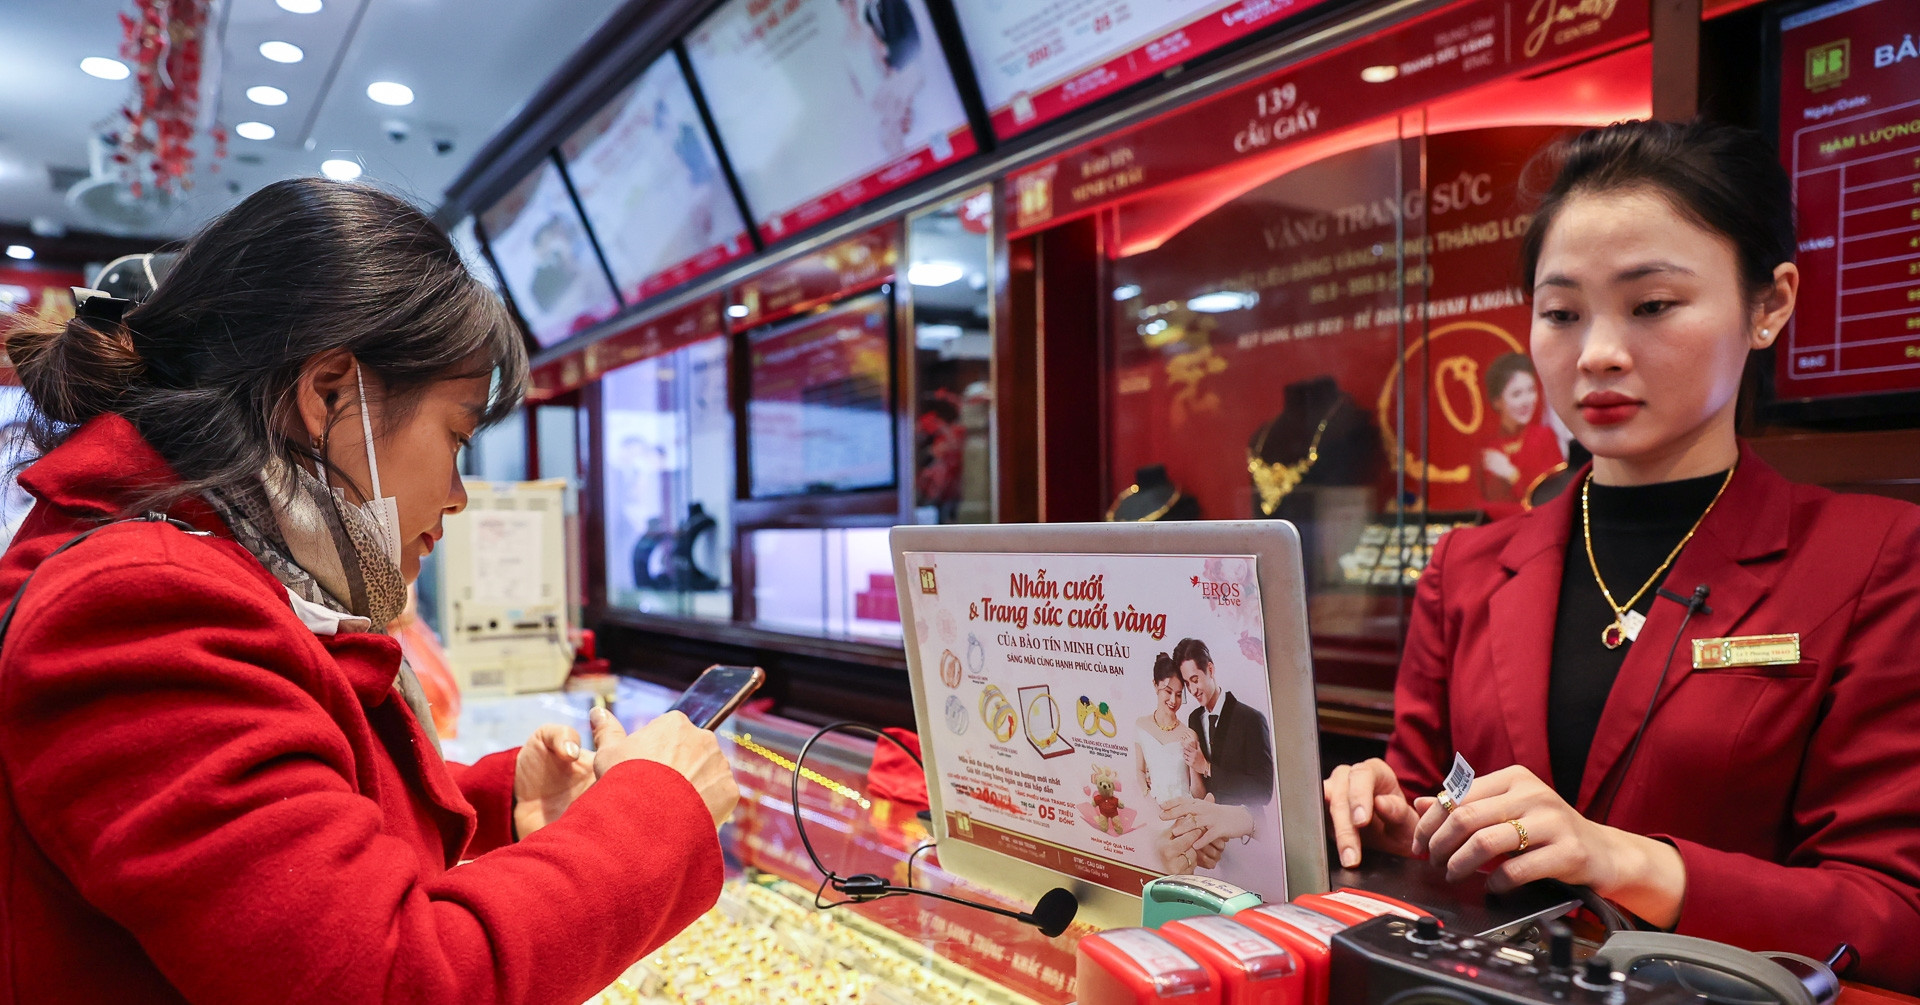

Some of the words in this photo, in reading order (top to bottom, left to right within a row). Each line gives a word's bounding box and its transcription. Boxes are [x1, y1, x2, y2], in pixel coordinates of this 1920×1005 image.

[1874, 33, 1920, 69] BẢ
[1257, 82, 1297, 117] 139
[1233, 119, 1271, 154] CẦU
[1273, 101, 1320, 140] GIẤY
[1336, 190, 1424, 234] TRANG
[1431, 170, 1492, 214] SỨC
[1010, 568, 1060, 600] Nhẫn
[1063, 574, 1105, 602] cưới
[1202, 582, 1240, 598] EROS
[1218, 596, 1241, 607] Love
[969, 602, 979, 621] &
[981, 598, 1029, 631] Trang
[1033, 601, 1063, 628] sức
[1067, 603, 1110, 631] cưới
[1113, 604, 1168, 642] vàng
[997, 632, 1018, 648] CỦA
[1019, 634, 1041, 650] BẢO
[1042, 636, 1062, 652] TÍN
[1063, 640, 1095, 656] MINH
[1096, 642, 1131, 660] CHÂU
[1056, 659, 1074, 671] HẠNH
[1075, 660, 1093, 672] PHÚC
[1094, 662, 1108, 673] CỦA
[1109, 665, 1124, 677] BẠN
[1038, 804, 1055, 821] 05
[1051, 799, 1066, 807] TRANG
[1058, 808, 1074, 818] TRIỆU
[1058, 816, 1075, 826] ĐỒNG
